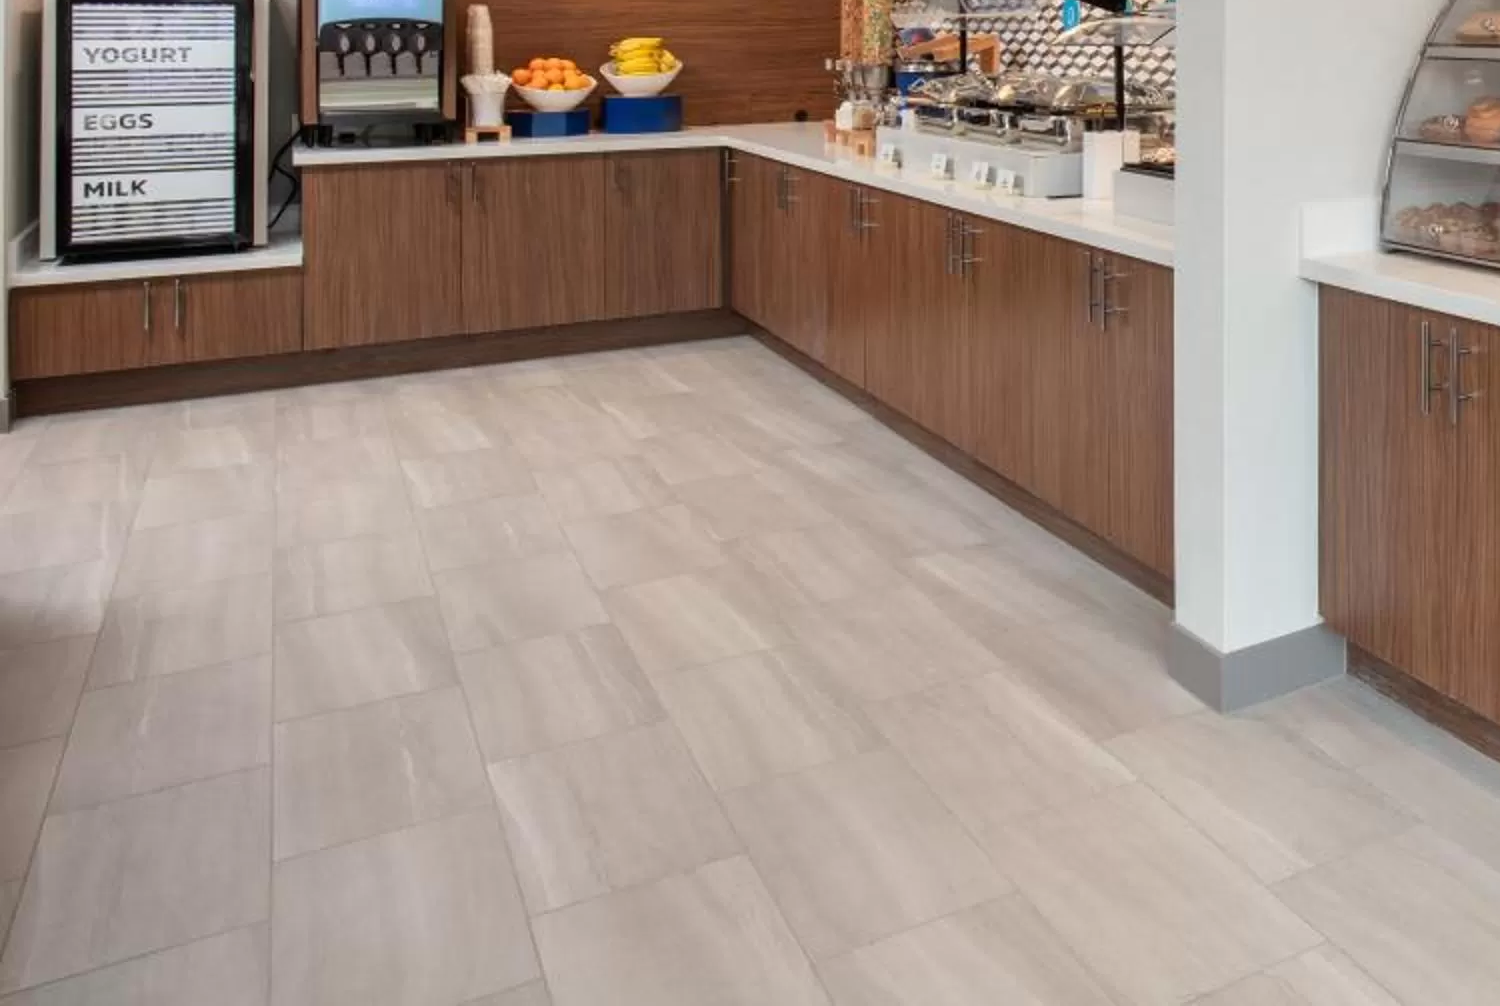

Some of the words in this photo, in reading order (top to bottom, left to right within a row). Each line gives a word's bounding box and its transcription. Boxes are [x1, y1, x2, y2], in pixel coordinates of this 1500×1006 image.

[83, 47, 193, 64] YOGURT
[83, 113, 154, 131] EGGS
[83, 179, 149, 199] MILK
